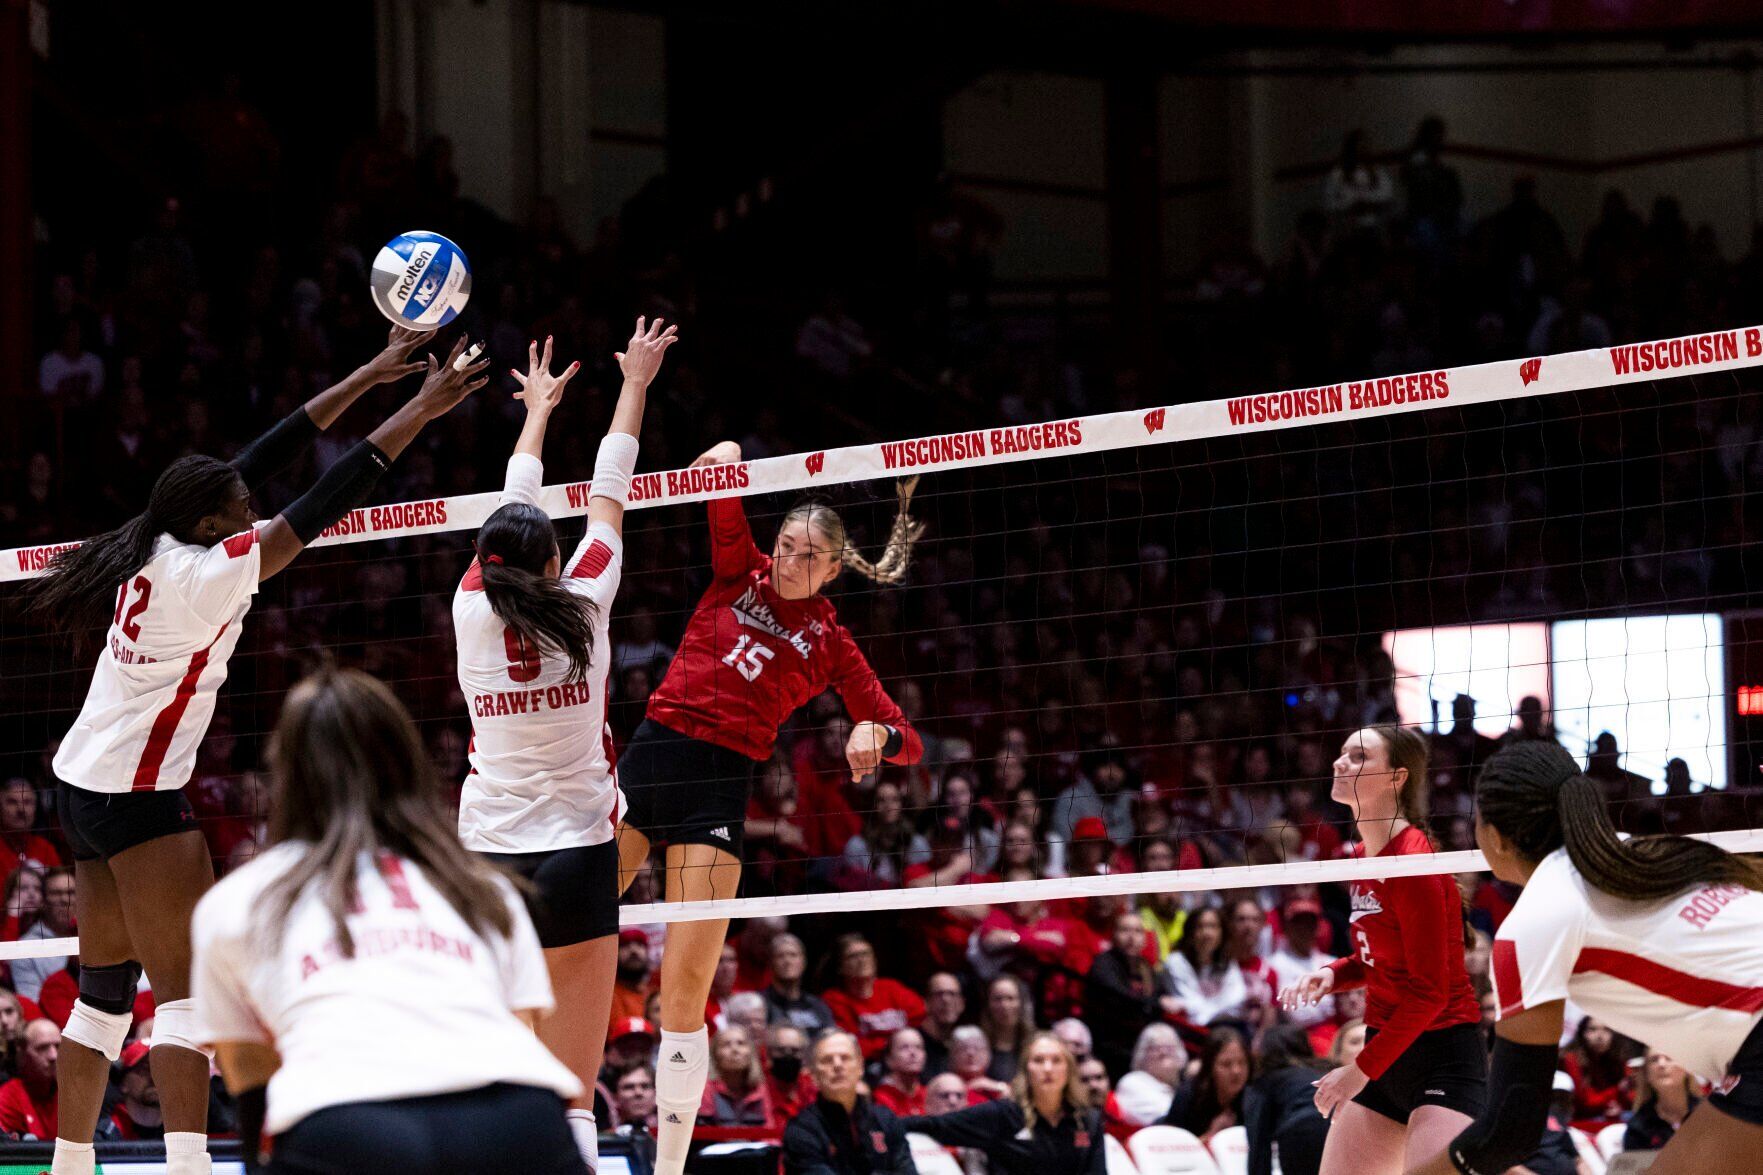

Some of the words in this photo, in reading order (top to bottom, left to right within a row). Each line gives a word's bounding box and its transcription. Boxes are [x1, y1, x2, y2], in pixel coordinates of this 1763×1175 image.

[397, 250, 432, 301] molten
[1610, 331, 1740, 376] WISCONSIN
[1745, 328, 1763, 358] B
[1227, 384, 1343, 426] WISCONSIN
[1348, 371, 1450, 410] BADGERS
[881, 432, 986, 469] WISCONSIN
[990, 420, 1083, 456] BADGERS
[667, 463, 750, 497] BADGERS
[370, 500, 447, 532] BADGERS
[114, 575, 152, 644] 12
[730, 585, 813, 660] Nebraska
[503, 623, 542, 683] 9
[721, 633, 776, 683] 15
[474, 681, 591, 718] CRAWFORD
[1355, 930, 1375, 968] 2
